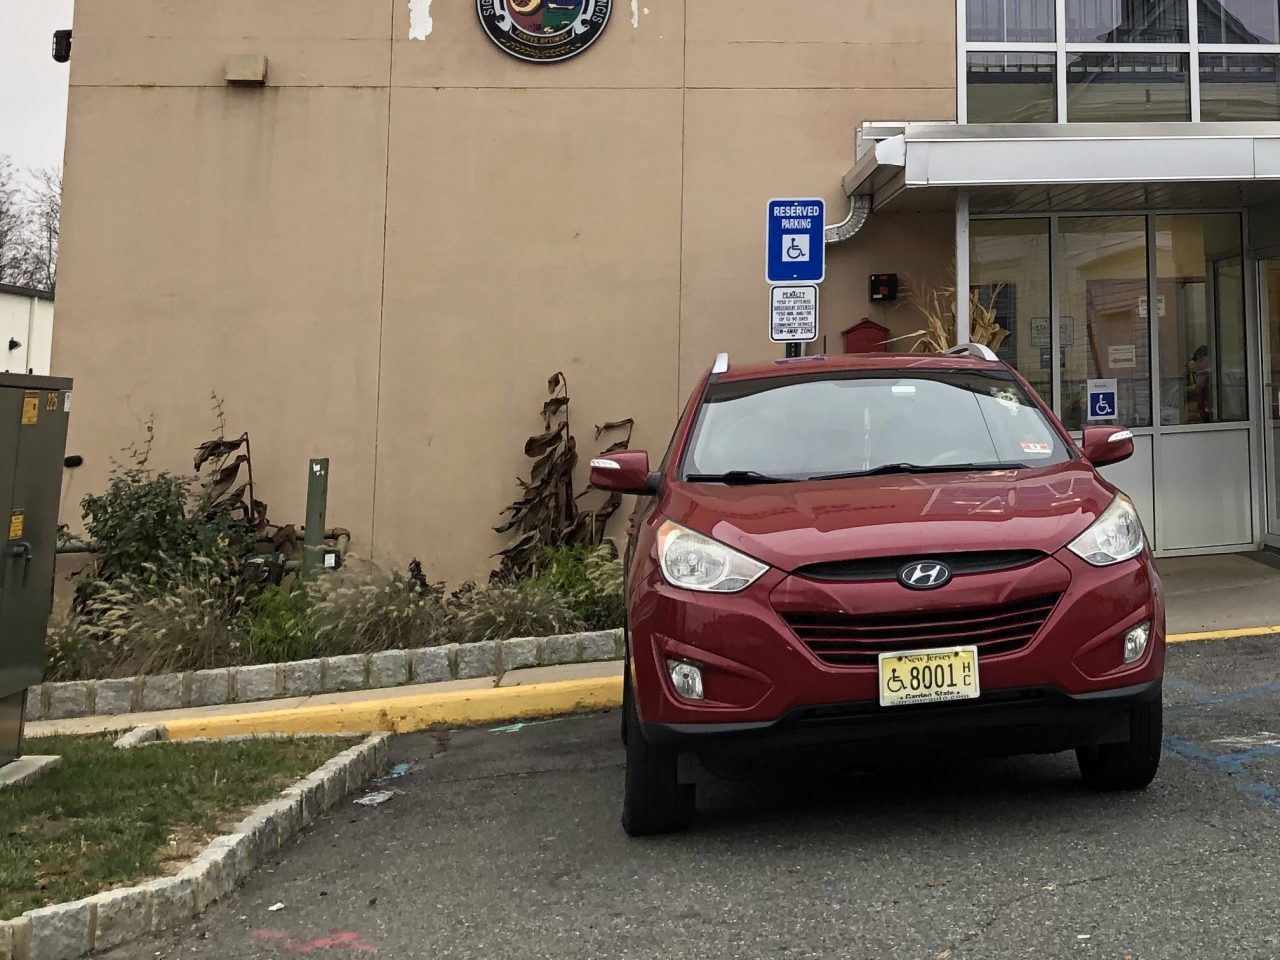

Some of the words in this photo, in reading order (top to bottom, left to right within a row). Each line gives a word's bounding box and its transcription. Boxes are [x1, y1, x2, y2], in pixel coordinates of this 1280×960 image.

[774, 206, 820, 216] RESERVED
[781, 218, 812, 229] PARKING
[904, 656, 925, 664] New
[926, 653, 952, 664] Jersey
[910, 663, 958, 690] 8001
